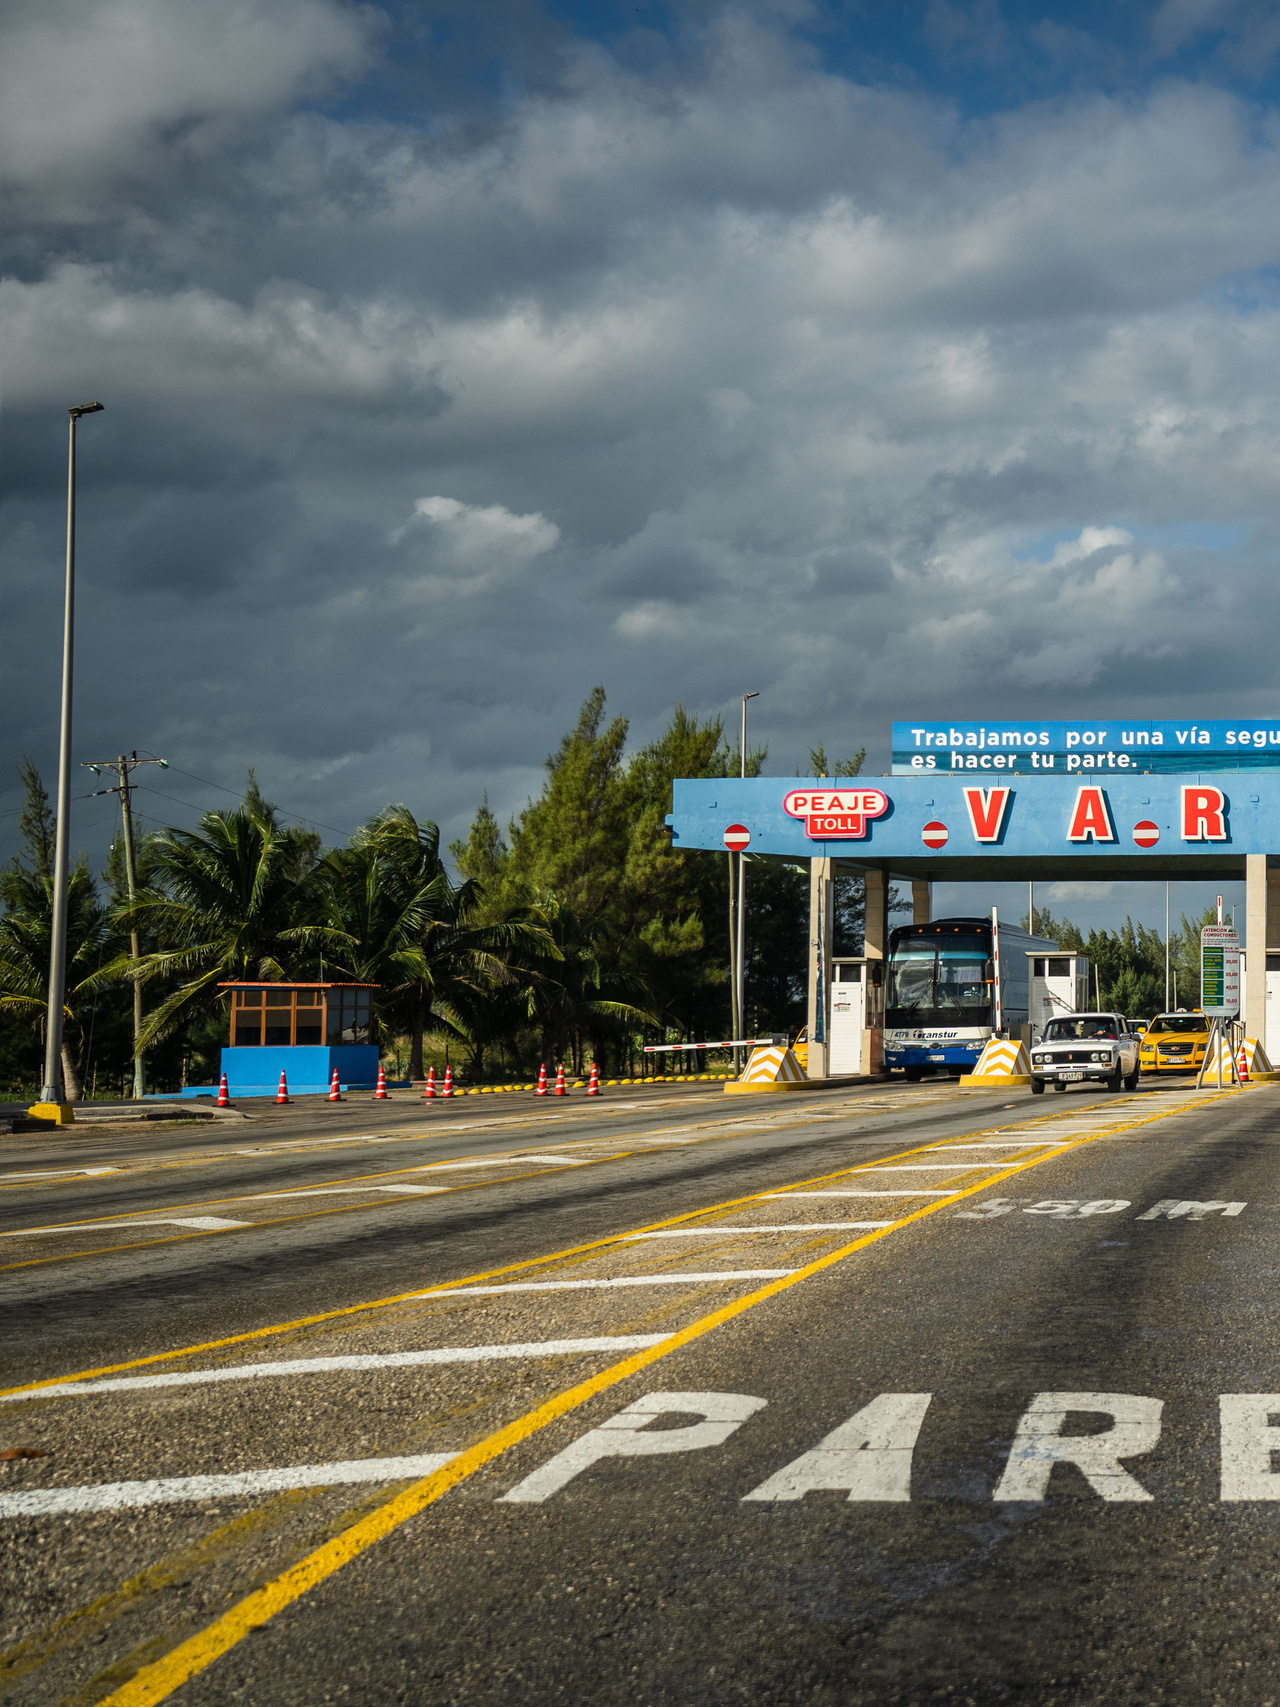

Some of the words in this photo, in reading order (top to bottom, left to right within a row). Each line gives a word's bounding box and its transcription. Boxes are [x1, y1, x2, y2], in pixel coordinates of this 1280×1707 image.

[911, 729, 1050, 750] Trabajamos
[1066, 731, 1107, 749] por
[1122, 731, 1163, 746] una
[1175, 727, 1210, 745] vía
[911, 755, 937, 769] es
[951, 751, 1017, 769] hacer
[1031, 752, 1055, 768] tu
[1067, 752, 1138, 771] parte.
[793, 795, 877, 812] PEAJE
[813, 817, 858, 831] TOLL
